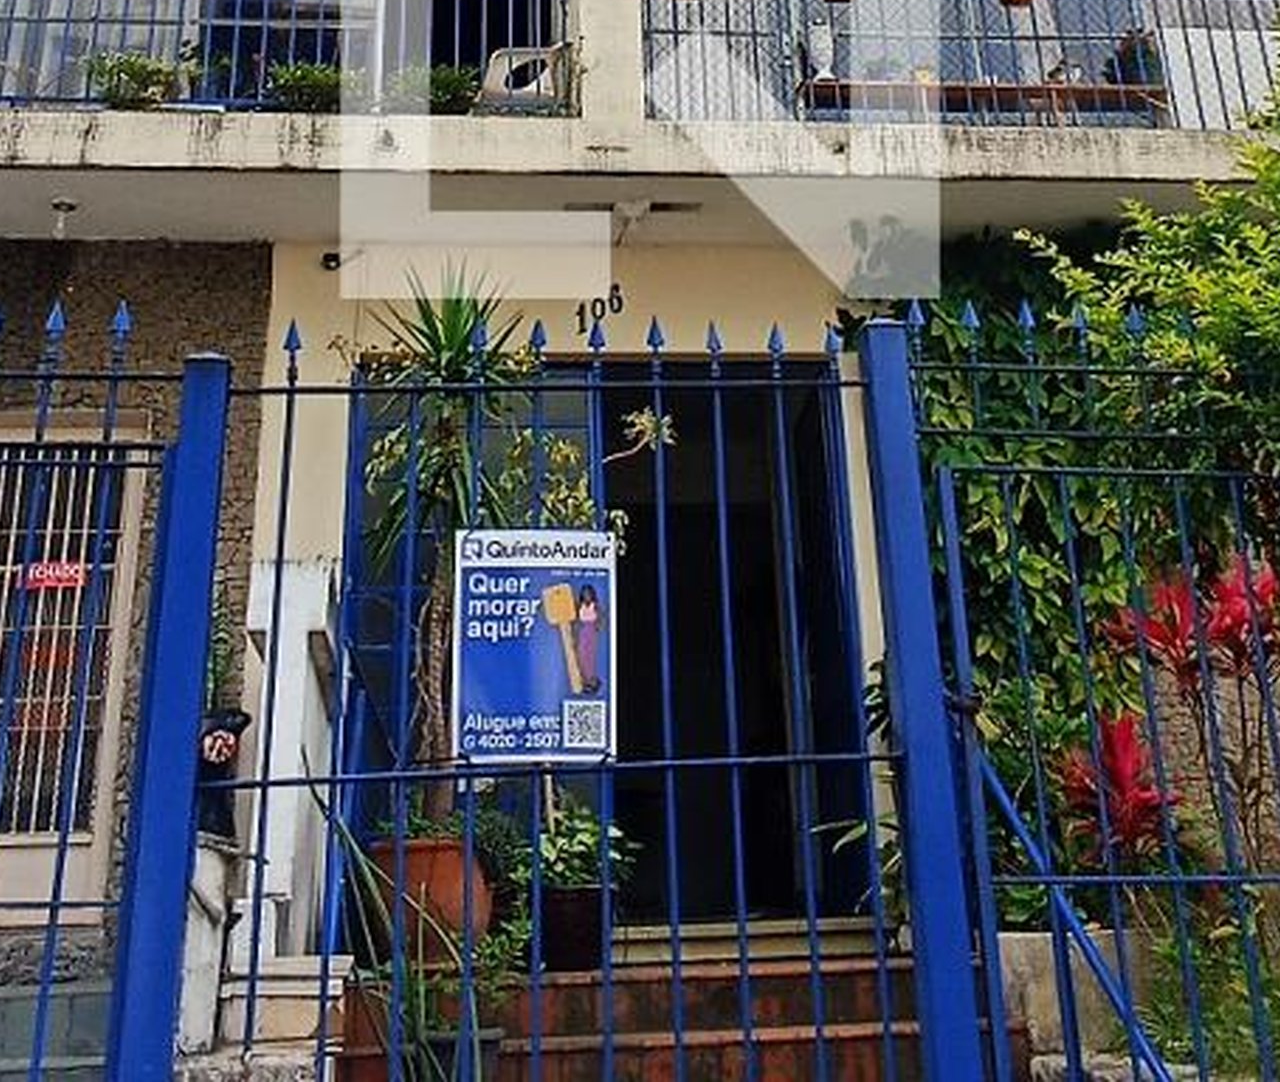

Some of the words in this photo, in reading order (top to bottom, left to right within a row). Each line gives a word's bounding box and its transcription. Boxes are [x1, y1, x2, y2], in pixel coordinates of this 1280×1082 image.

[576, 283, 623, 335] 106
[486, 540, 610, 559] QuintoAndar
[468, 573, 530, 593] Quer
[468, 599, 541, 616] morar
[467, 616, 535, 643] aqui?
[463, 713, 526, 733] Alugue
